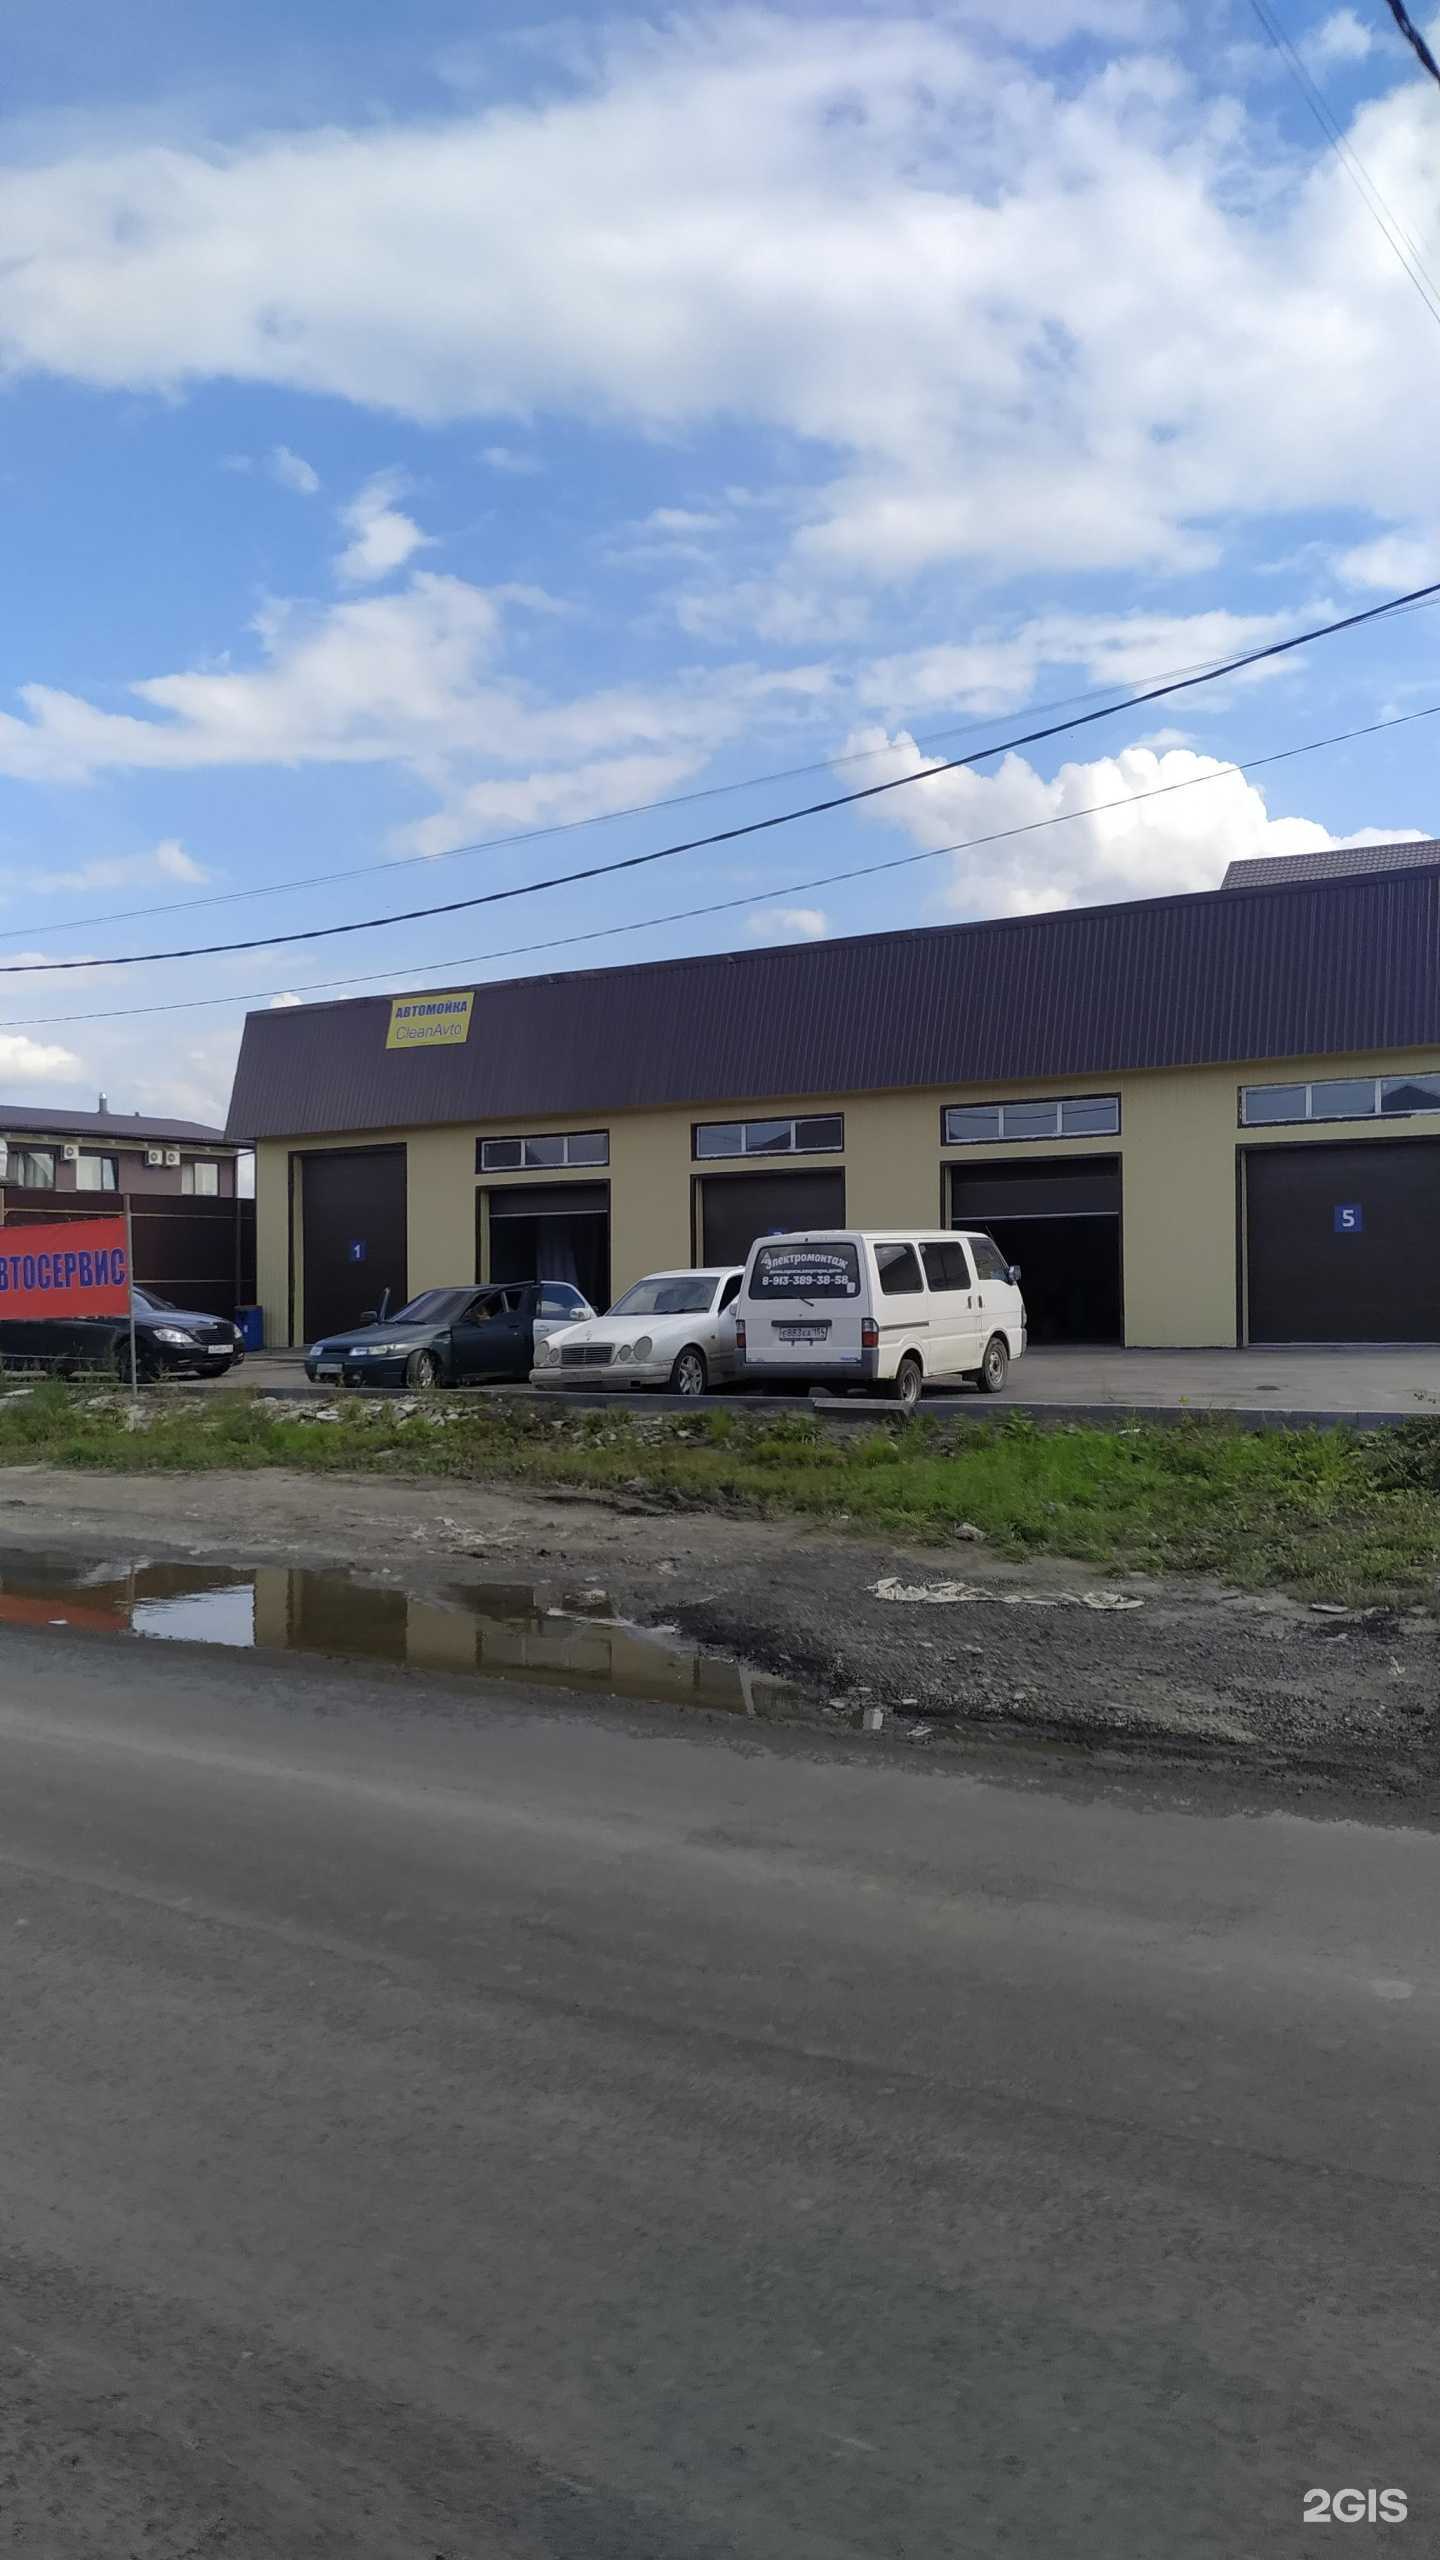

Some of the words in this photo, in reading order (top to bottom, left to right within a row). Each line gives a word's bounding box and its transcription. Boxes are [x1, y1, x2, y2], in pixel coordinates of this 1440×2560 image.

[396, 1000, 467, 1018] АВТОМОЙКА
[396, 1024, 462, 1040] CleanAvto
[1343, 1209, 1355, 1227] 5
[354, 1244, 361, 1258] 1
[762, 1275, 849, 1286] 8-913-389-38-58
